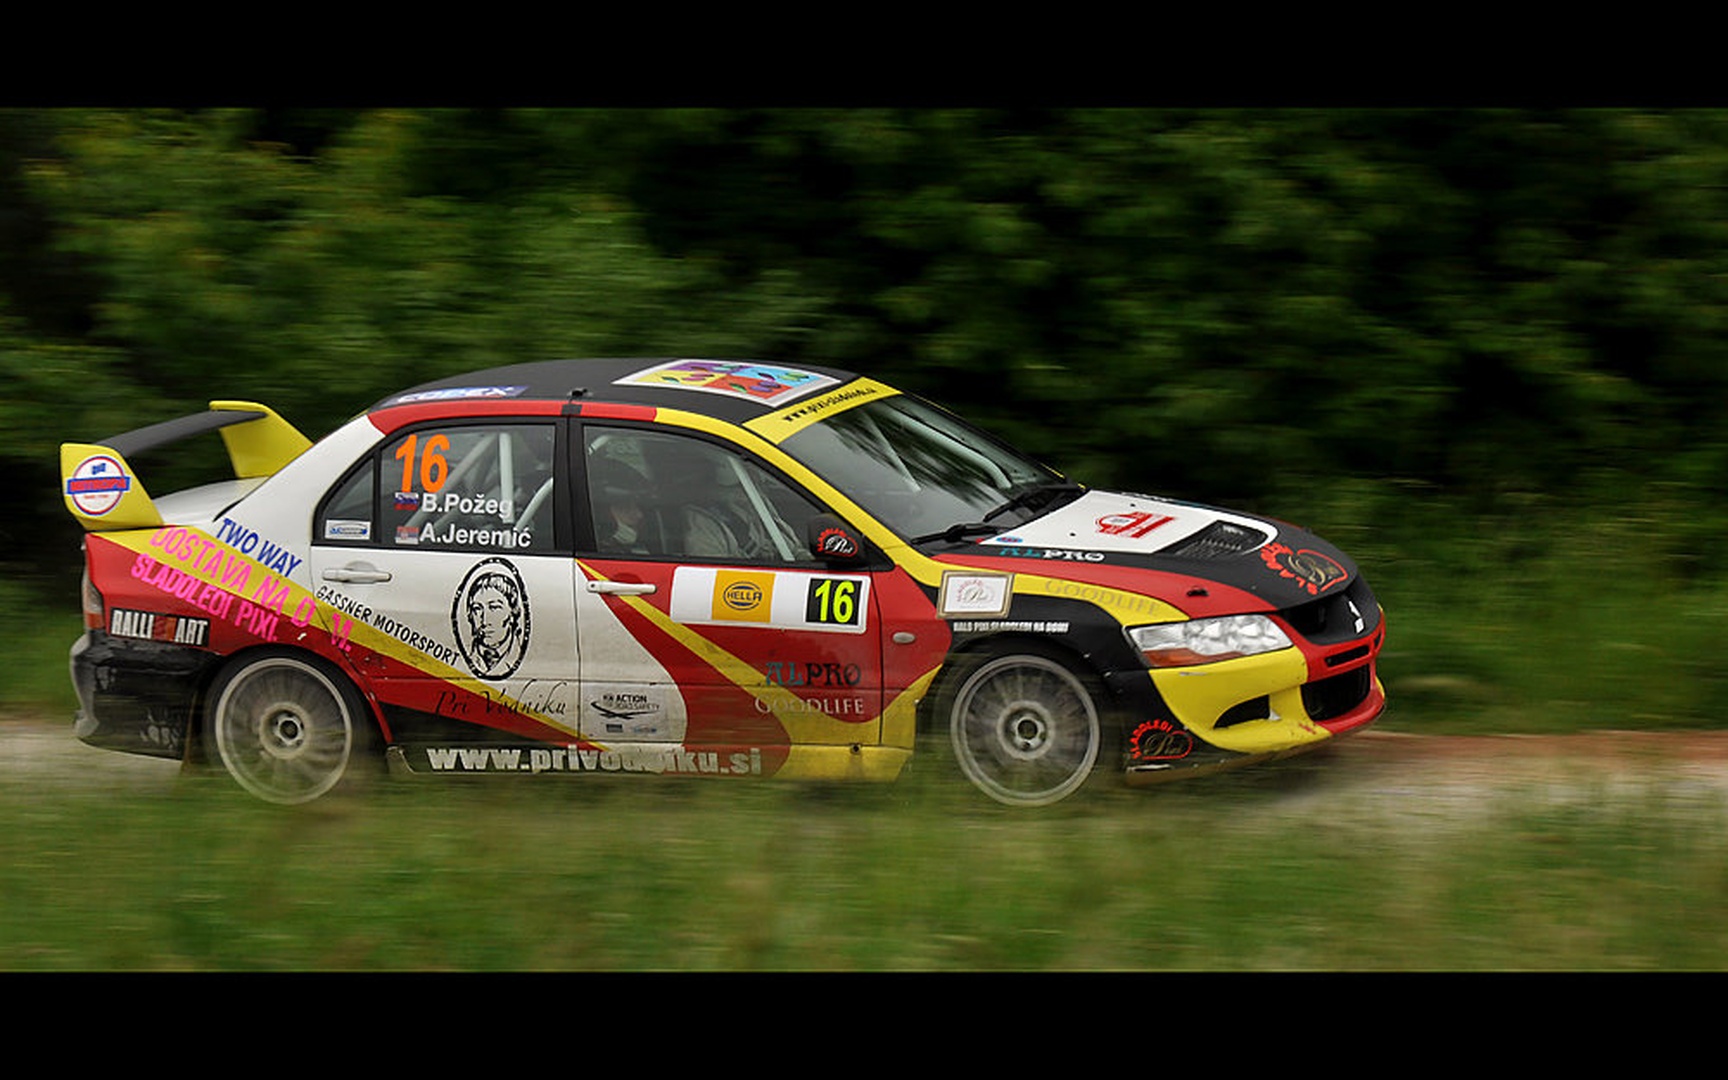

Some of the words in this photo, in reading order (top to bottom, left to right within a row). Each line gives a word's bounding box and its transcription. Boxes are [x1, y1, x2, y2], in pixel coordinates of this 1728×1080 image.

[395, 433, 451, 493] 16
[421, 493, 514, 520] B.Požeg
[215, 517, 258, 556] TWO
[256, 540, 303, 579] WAY
[419, 522, 532, 548] A.Jeremić
[998, 547, 1106, 563] ALPRO
[149, 526, 252, 594] DOSTAVA
[251, 575, 285, 617] NA
[131, 552, 234, 621] SLADOLEDI
[726, 590, 763, 603] HELLA
[815, 579, 856, 624] 16
[111, 609, 155, 640] RALLI
[174, 617, 209, 647] ART
[315, 584, 373, 625] GASSNER
[373, 613, 461, 667] MOTORSPORT
[764, 661, 862, 687] ALPRO
[435, 690, 471, 717] Pri
[616, 693, 648, 703] ACTION
[754, 695, 865, 716] GOODLIFE
